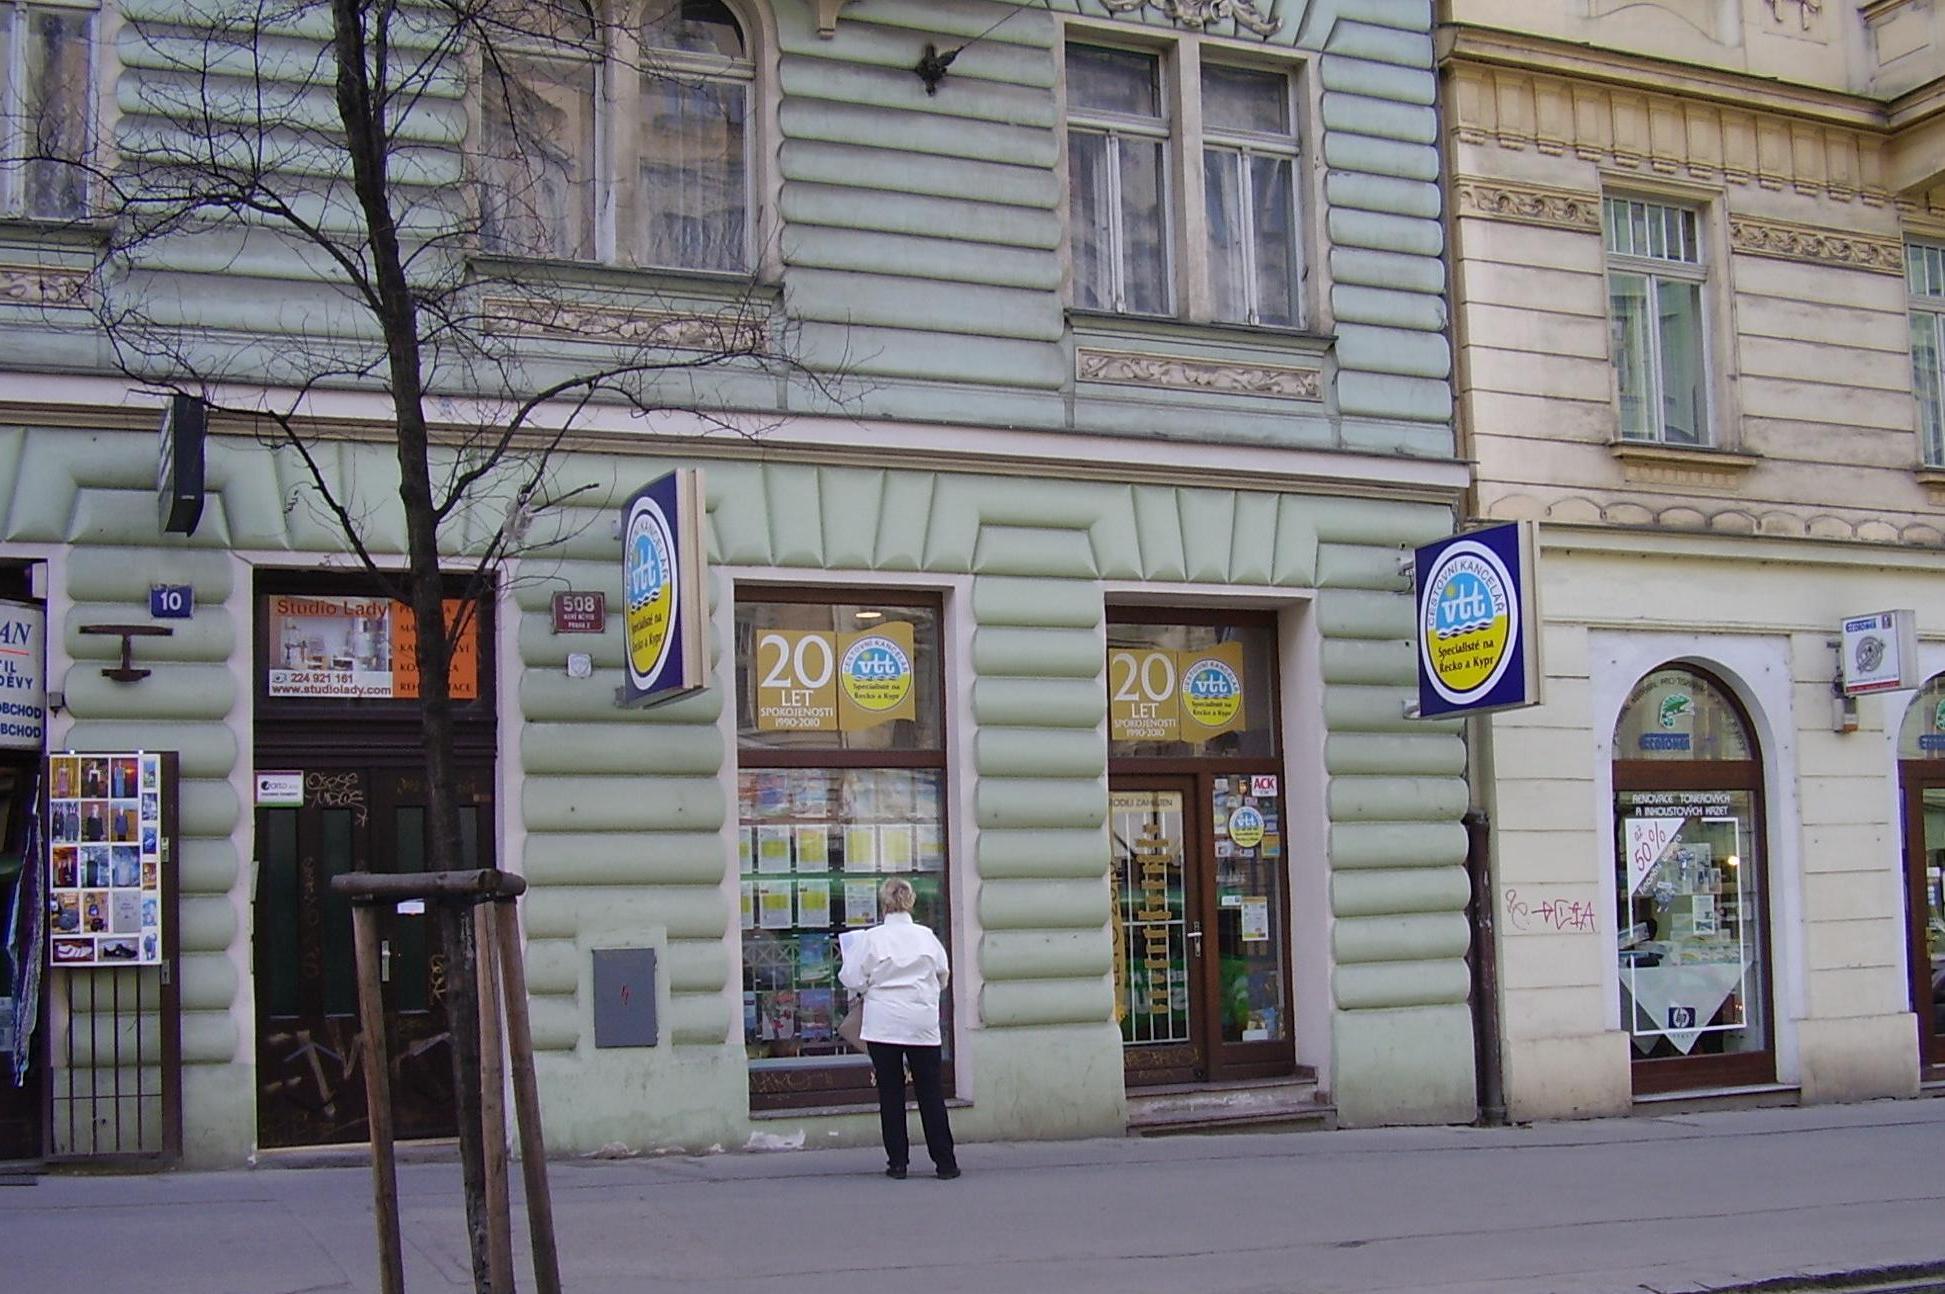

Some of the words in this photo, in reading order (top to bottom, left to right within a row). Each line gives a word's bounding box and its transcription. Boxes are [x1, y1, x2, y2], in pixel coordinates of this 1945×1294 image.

[161, 592, 182, 611] 10
[563, 596, 595, 612] 508
[1441, 581, 1485, 624] vtt
[277, 600, 336, 615] Studio
[344, 601, 387, 621] Lady
[1437, 641, 1479, 660] Specialisté
[1482, 640, 1494, 648] na
[760, 634, 833, 688] 20
[857, 653, 896, 674] vtt
[1465, 661, 1471, 669] a
[1473, 656, 1494, 669] Kypr
[290, 673, 310, 683] 224
[312, 673, 331, 683] 921
[1112, 653, 1175, 702] 20
[1195, 673, 1228, 693] vtt
[271, 684, 392, 698] www.studiolady.com
[782, 689, 814, 707] LET
[760, 707, 834, 717] SPOKOJENOSTI
[1131, 702, 1160, 719] LET
[775, 718, 820, 727] 1990-2010
[1113, 719, 1176, 729] SPOKOJENOSTI
[1635, 807, 1642, 816] A
